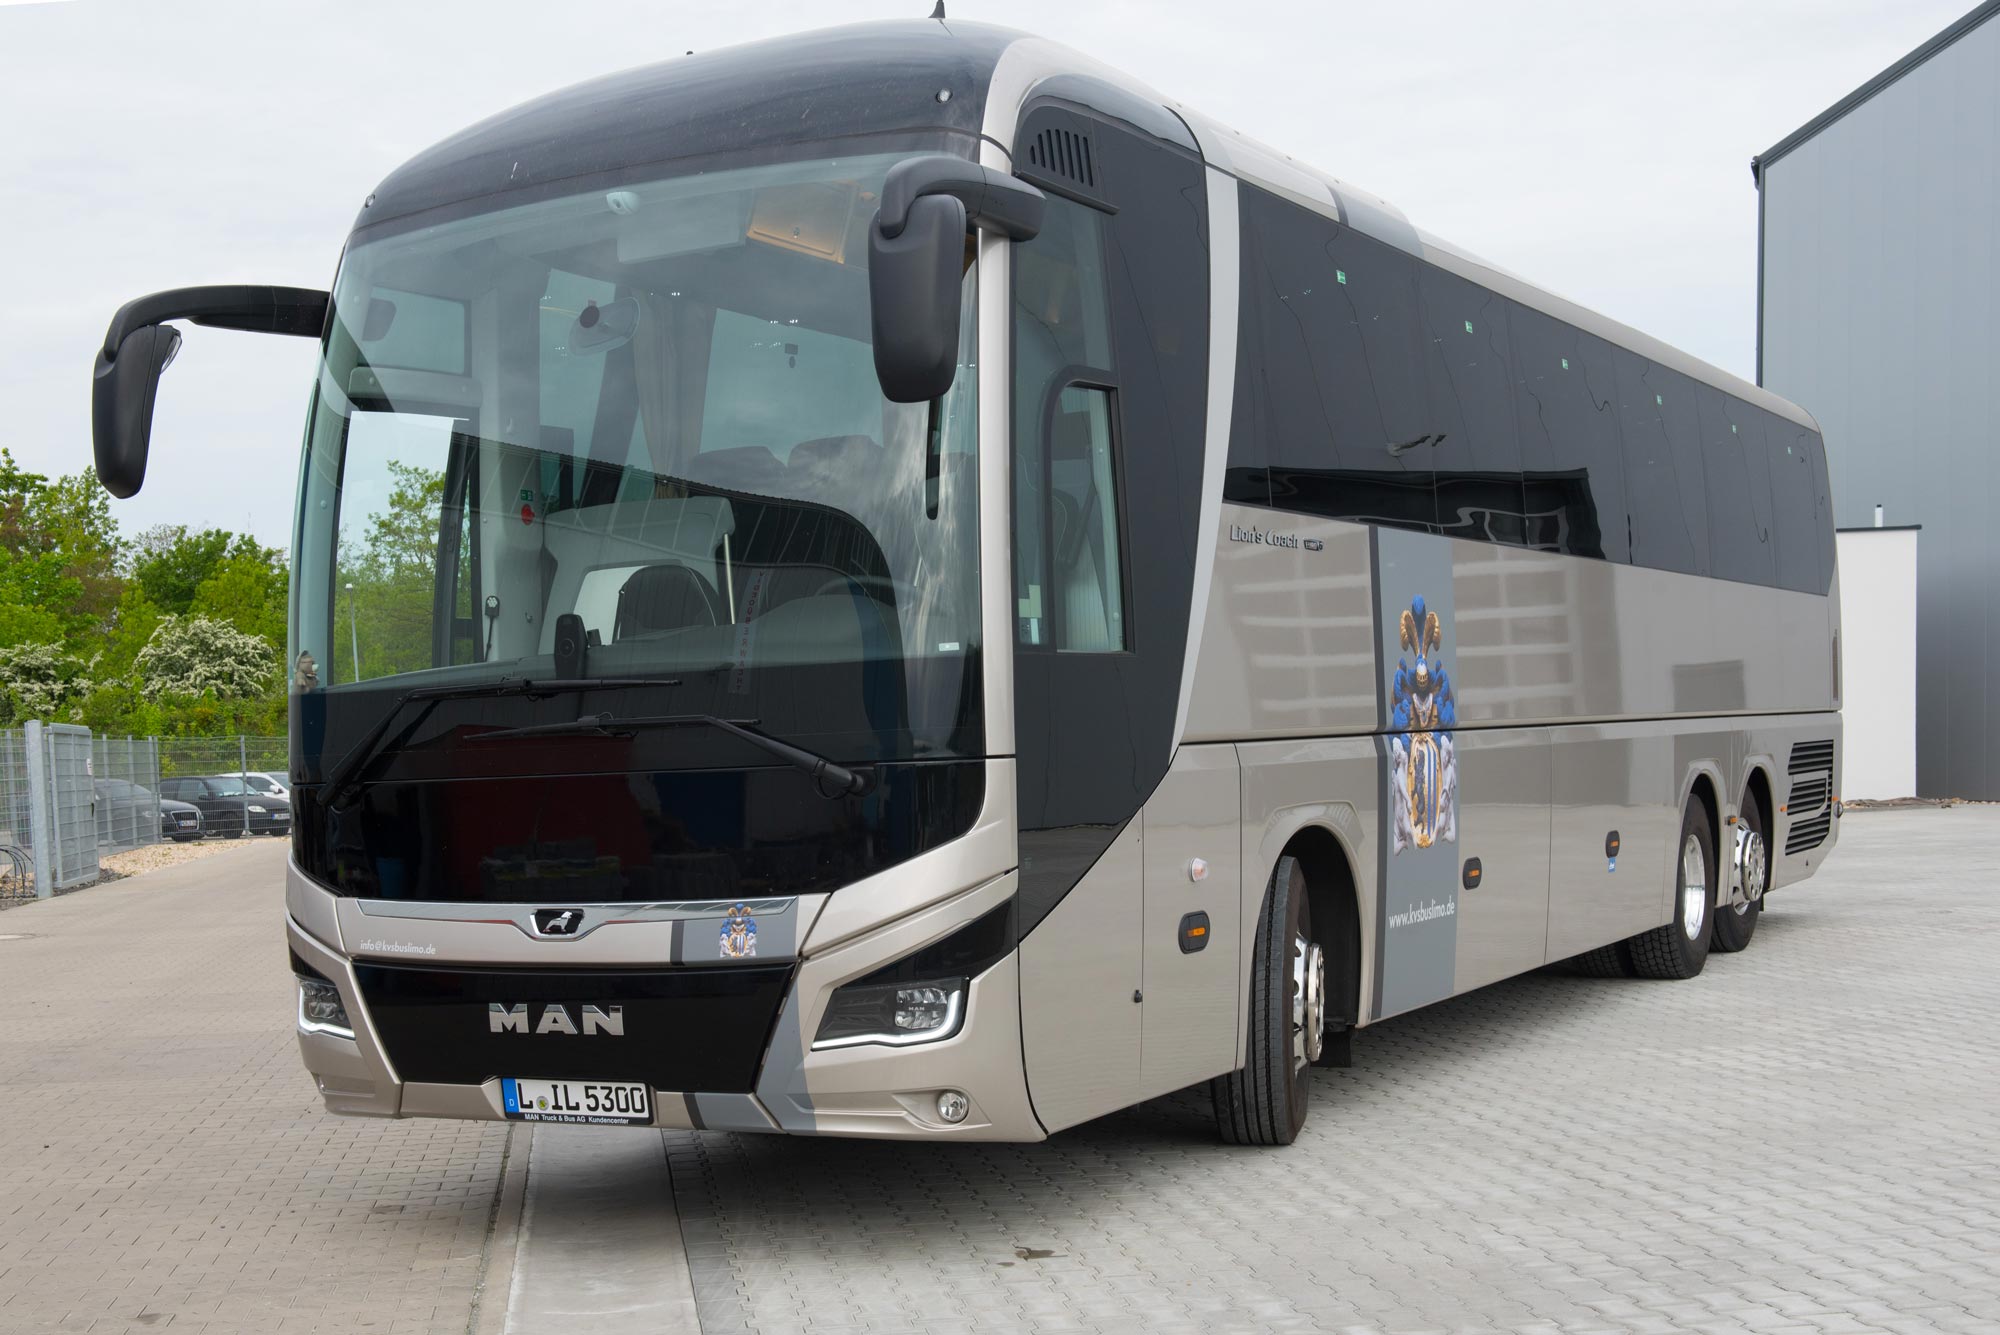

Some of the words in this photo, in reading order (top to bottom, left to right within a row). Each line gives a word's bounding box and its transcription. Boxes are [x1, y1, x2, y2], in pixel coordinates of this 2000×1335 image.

[1230, 525, 1263, 544] Lion's
[1265, 529, 1298, 548] Coach
[1388, 895, 1455, 928] www.kvsbuslimo.de
[359, 940, 437, 955] info@kvsbuslimo.de
[489, 1002, 625, 1036] MAN
[509, 1098, 514, 1107] D
[517, 1083, 533, 1109] L
[551, 1084, 580, 1111] IL
[584, 1085, 646, 1114] 5300
[524, 1113, 539, 1121] MAN
[541, 1114, 558, 1122] Truck
[564, 1115, 575, 1123] Bus
[588, 1117, 629, 1125] Kundencenter
